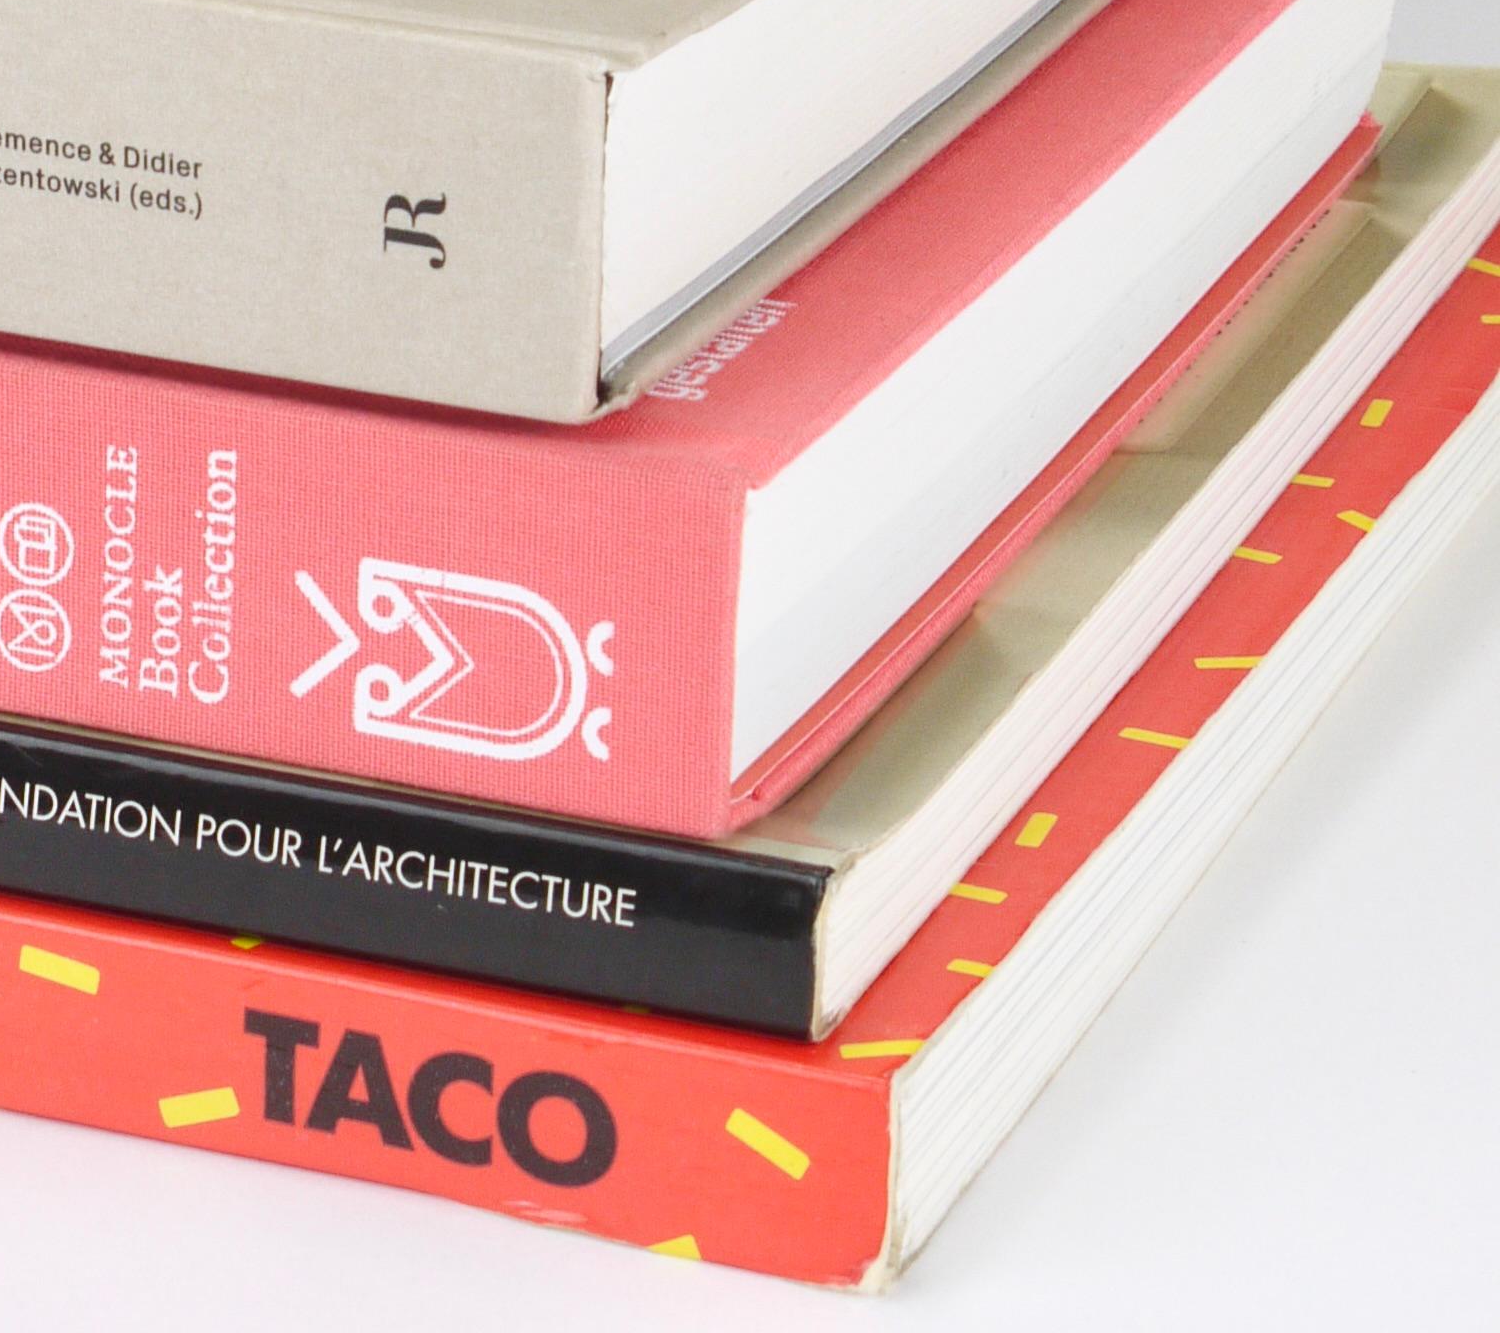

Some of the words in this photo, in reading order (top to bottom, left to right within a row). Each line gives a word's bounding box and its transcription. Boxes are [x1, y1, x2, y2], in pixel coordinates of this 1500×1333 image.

[98, 141, 116, 166] &
[122, 145, 203, 179] Didier
[129, 182, 203, 221] (eds.)
[99, 444, 138, 689] MONOCLE
[139, 563, 184, 700] Book
[187, 449, 238, 705] Collection
[194, 818, 303, 869] POUR
[243, 1007, 619, 1189] TACO
